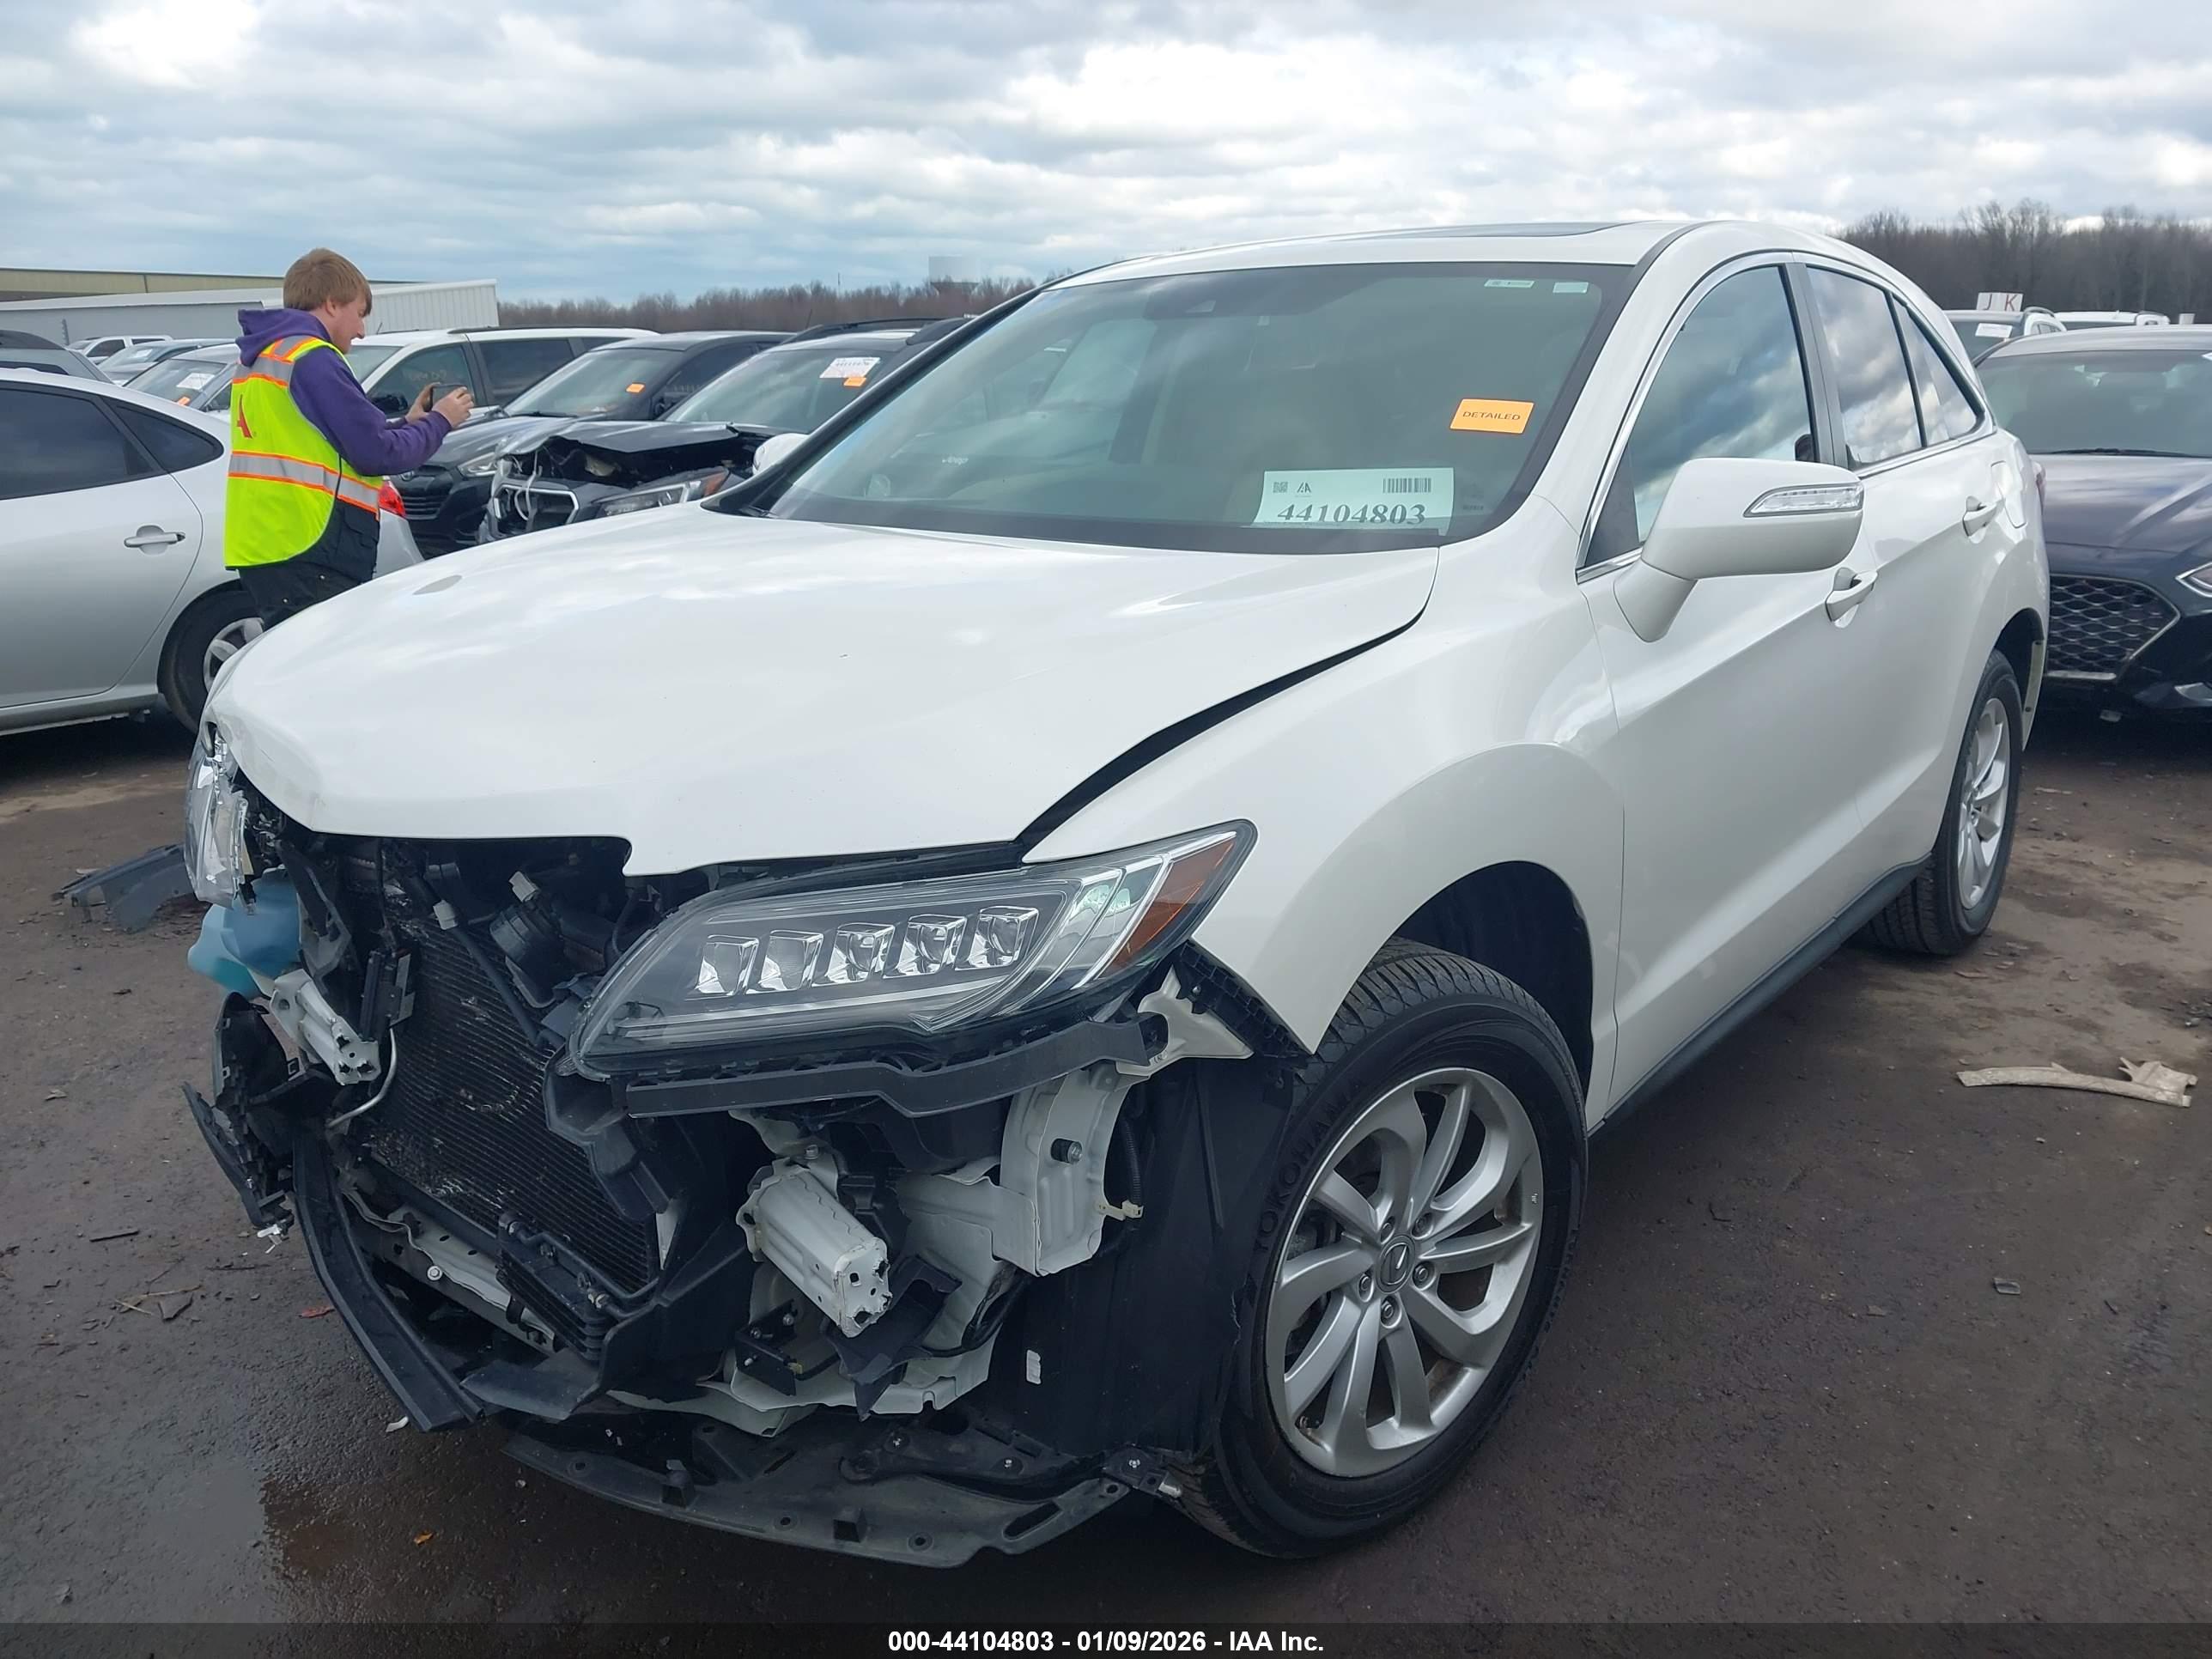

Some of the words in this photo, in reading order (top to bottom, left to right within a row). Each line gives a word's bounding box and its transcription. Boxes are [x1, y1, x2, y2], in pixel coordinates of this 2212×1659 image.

[1982, 294, 1993, 311] J
[2004, 294, 2018, 311] K
[1462, 410, 1521, 421] DETAILED
[1277, 503, 1426, 525] 44104803
